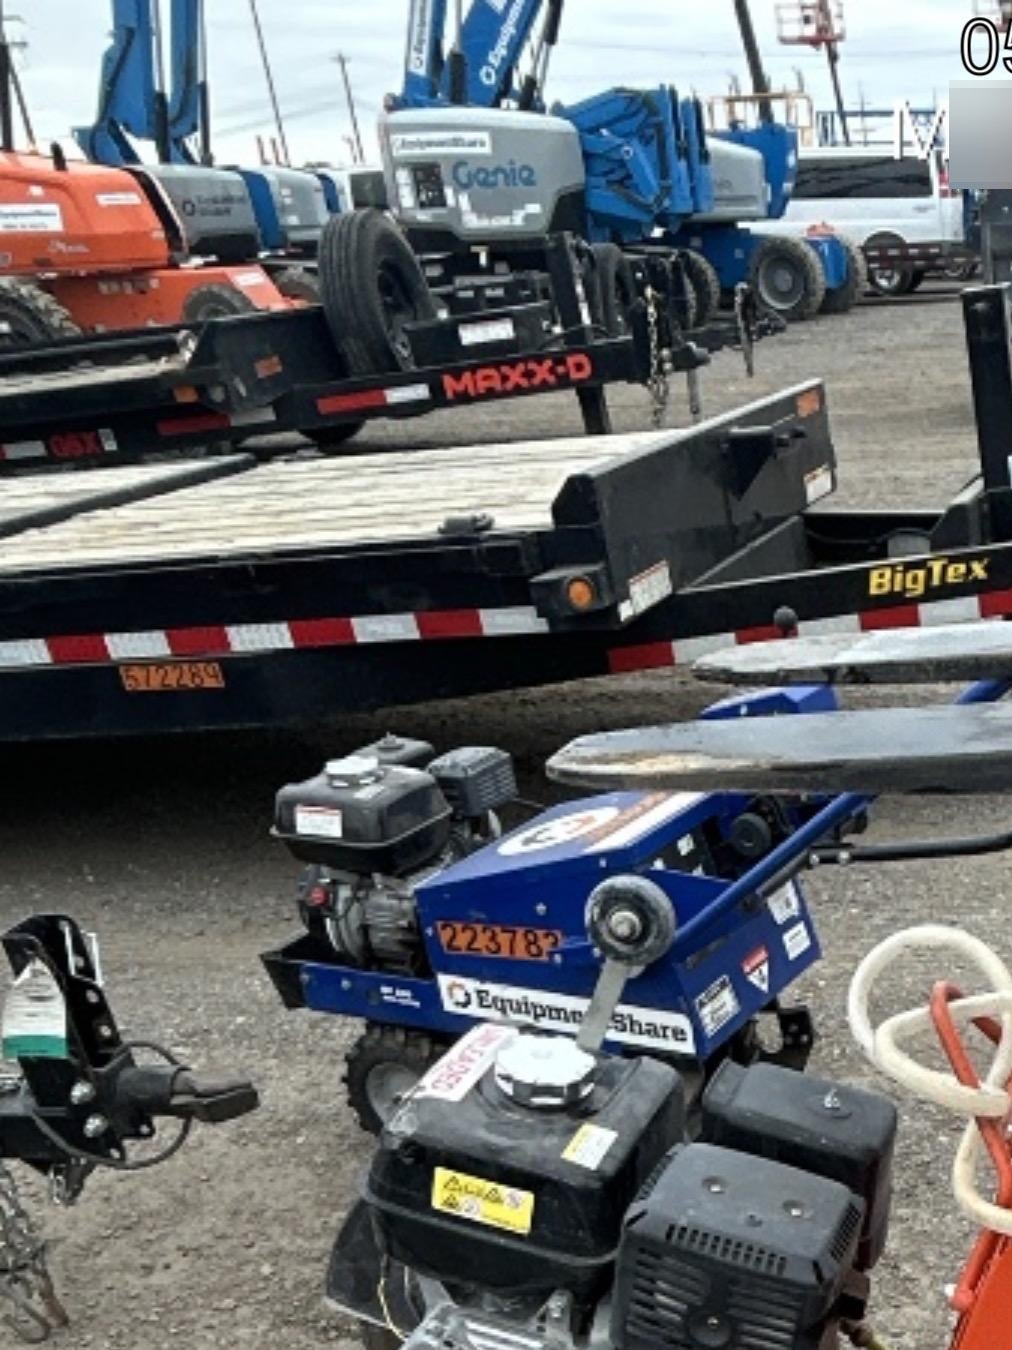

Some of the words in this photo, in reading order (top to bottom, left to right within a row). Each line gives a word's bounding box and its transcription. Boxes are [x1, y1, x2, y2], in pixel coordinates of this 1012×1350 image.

[452, 159, 537, 190] Genie
[442, 353, 593, 399] MAXX-D
[476, 989, 689, 1043] EquipmeShare
